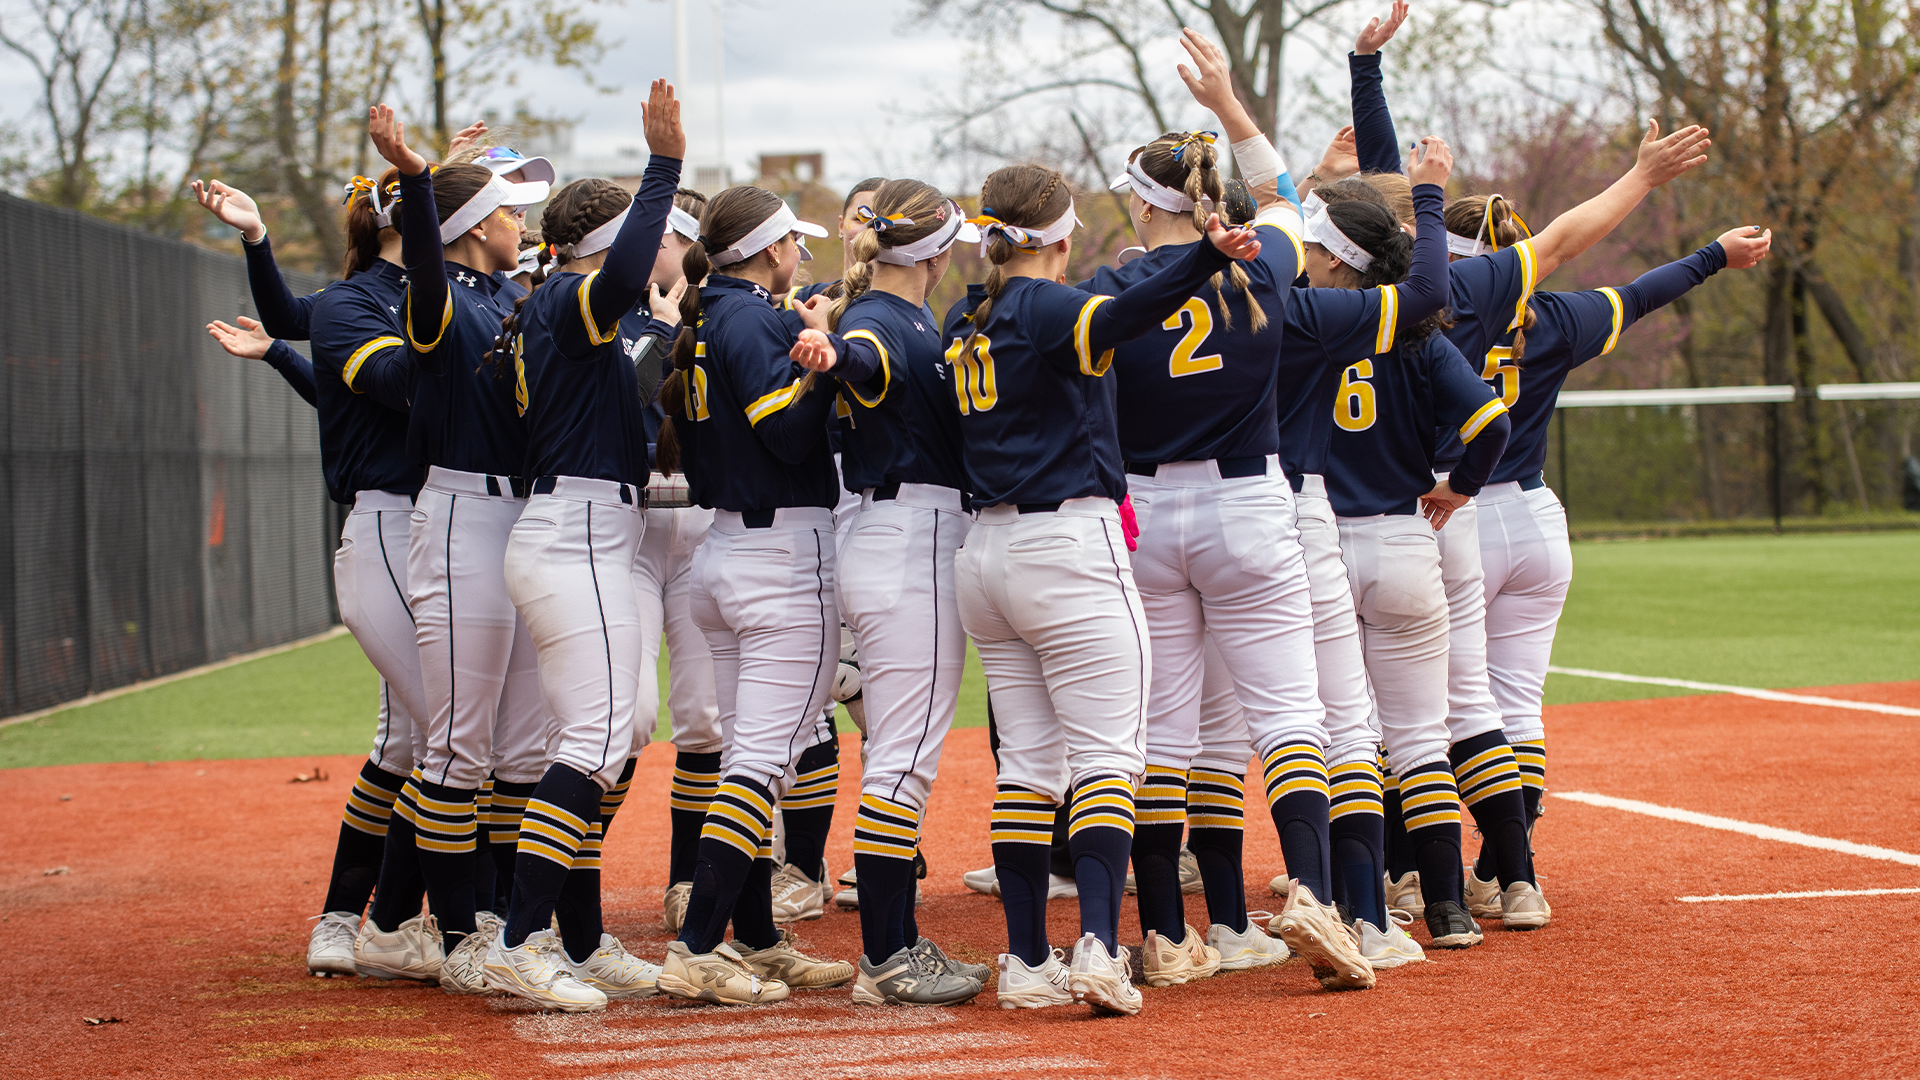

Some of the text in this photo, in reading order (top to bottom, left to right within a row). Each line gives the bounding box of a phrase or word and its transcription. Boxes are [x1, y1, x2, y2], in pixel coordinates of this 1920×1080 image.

[945, 333, 998, 416] 10
[1162, 295, 1223, 378] 2
[1333, 357, 1376, 432] 6
[1481, 345, 1521, 409] 5
